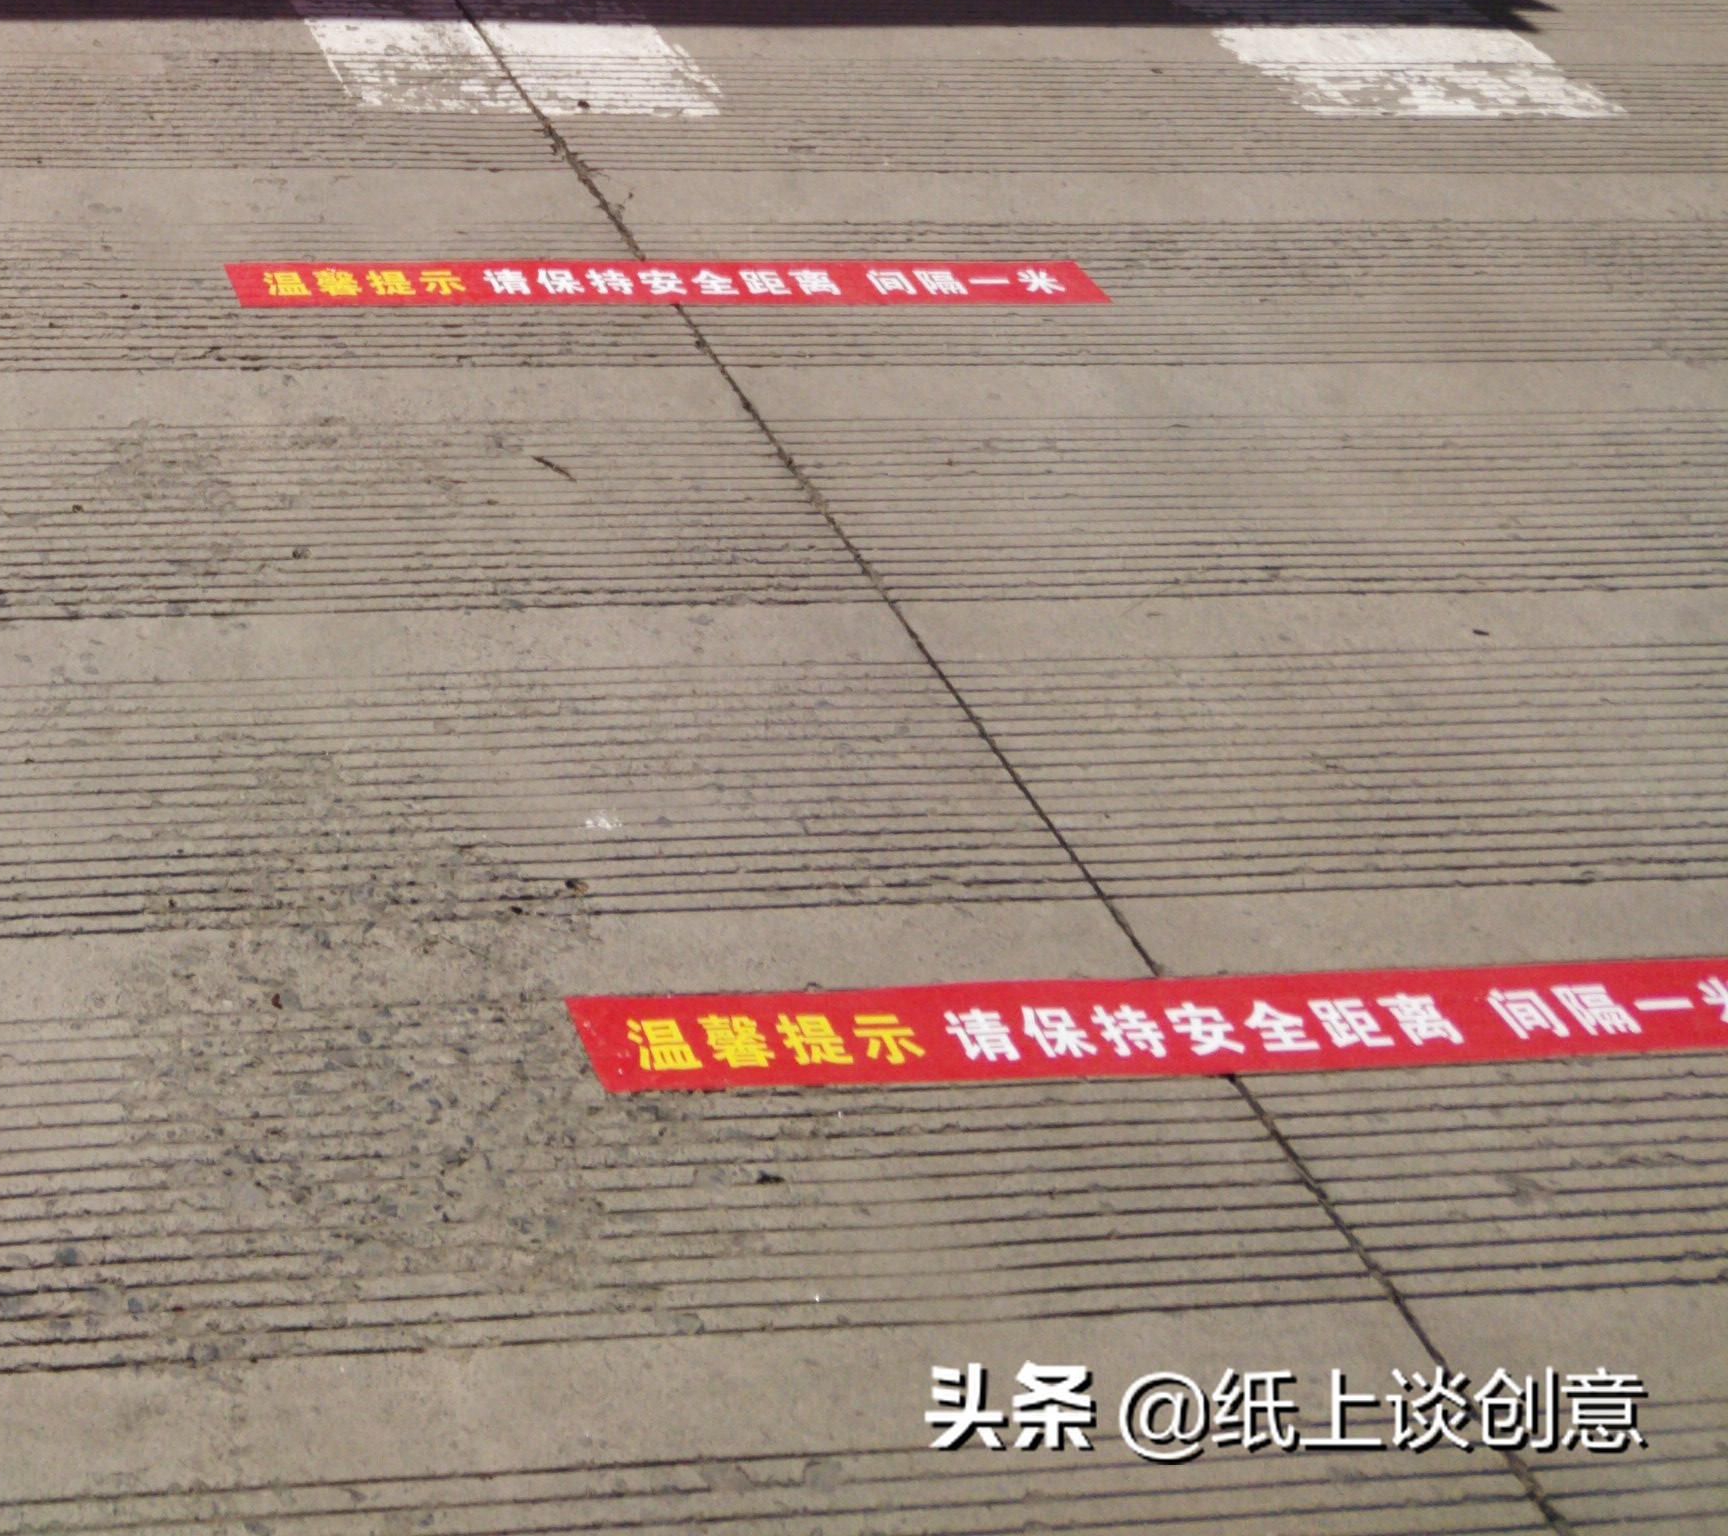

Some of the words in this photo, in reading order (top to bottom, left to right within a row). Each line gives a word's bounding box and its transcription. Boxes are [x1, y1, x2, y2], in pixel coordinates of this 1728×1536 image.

[262, 267, 469, 297] 温馨提示
[482, 267, 843, 297] 请保持安全距离
[865, 266, 1067, 296] 间隔一米
[626, 1013, 926, 1071] 温馨提示
[942, 991, 1465, 1062] 请保持安全距离
